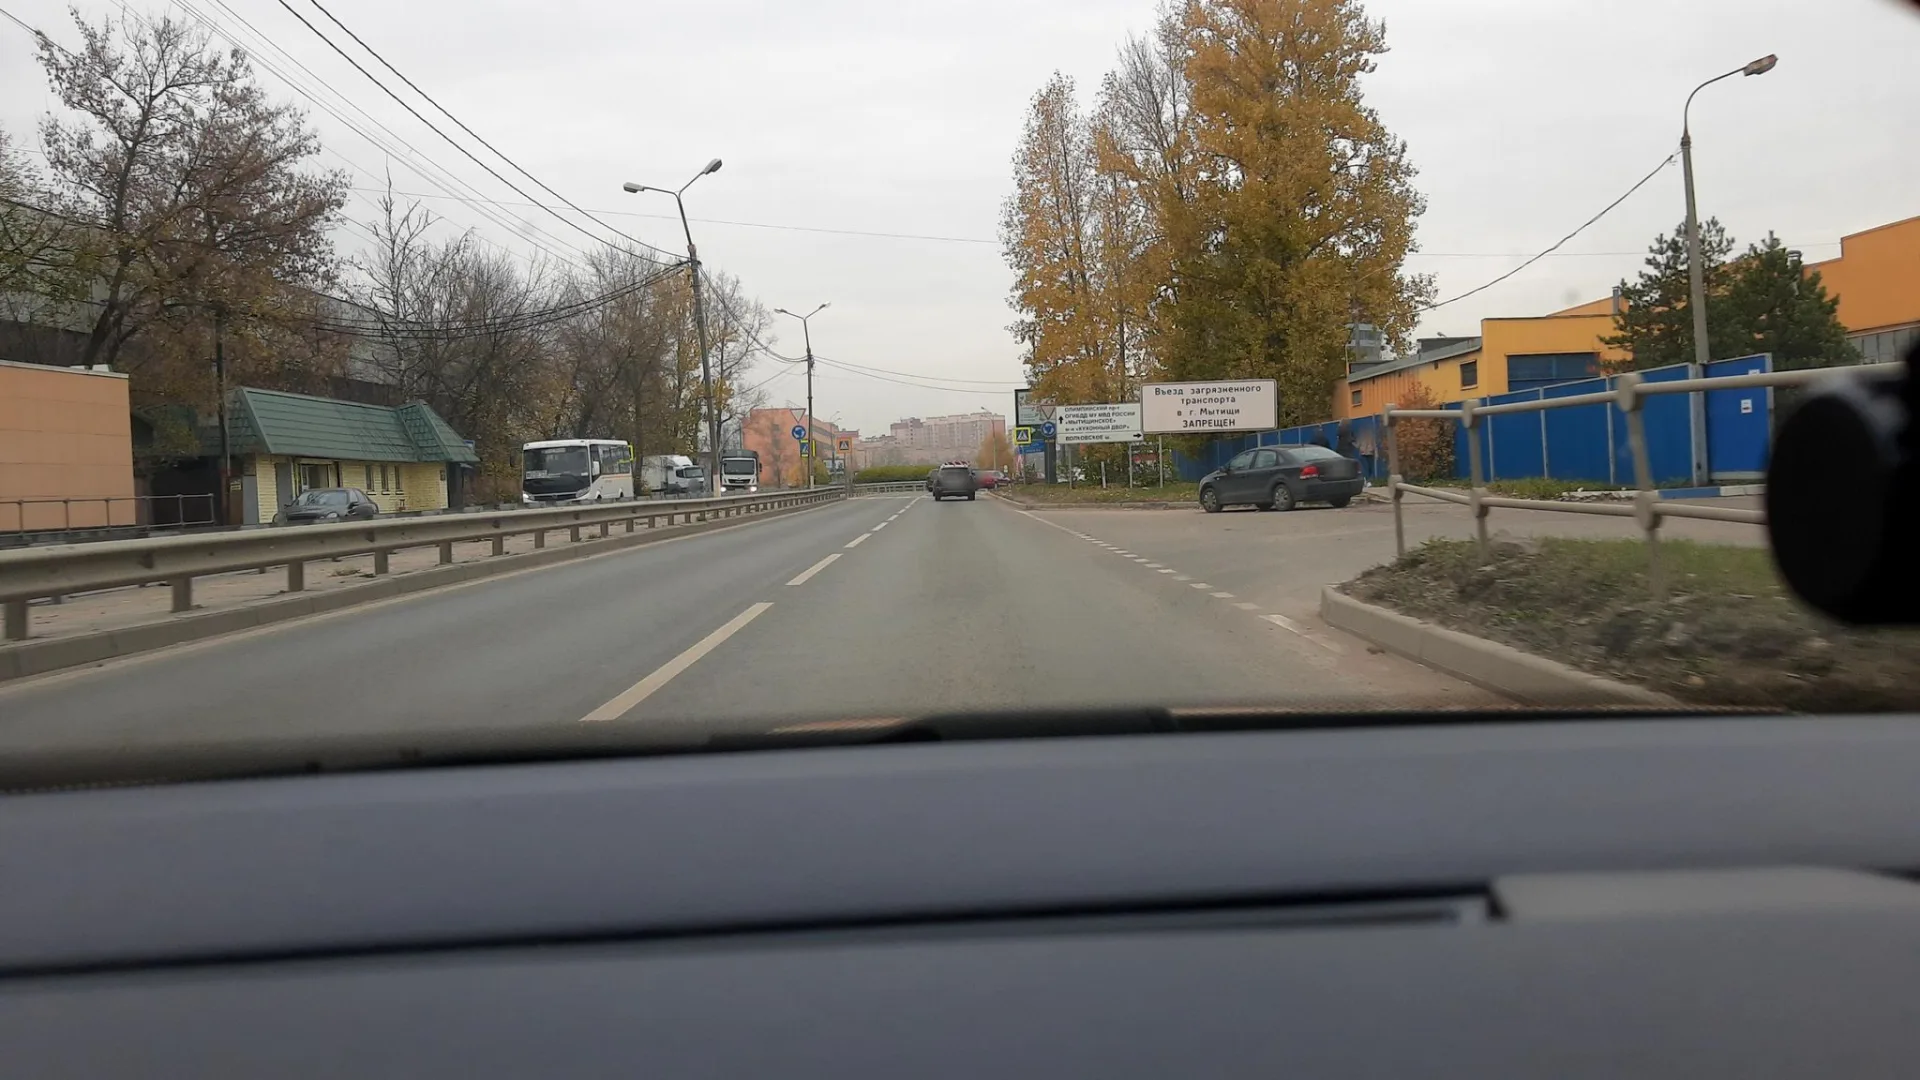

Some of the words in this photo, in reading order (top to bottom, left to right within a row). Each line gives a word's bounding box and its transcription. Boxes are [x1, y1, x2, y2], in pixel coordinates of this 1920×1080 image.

[1154, 387, 1184, 396] Въезд
[1190, 385, 1261, 395] загрязненного
[1181, 396, 1236, 406] транспорта
[1199, 408, 1240, 416] Мытищи
[1182, 418, 1236, 428] ЗАПРЕЩЕН
